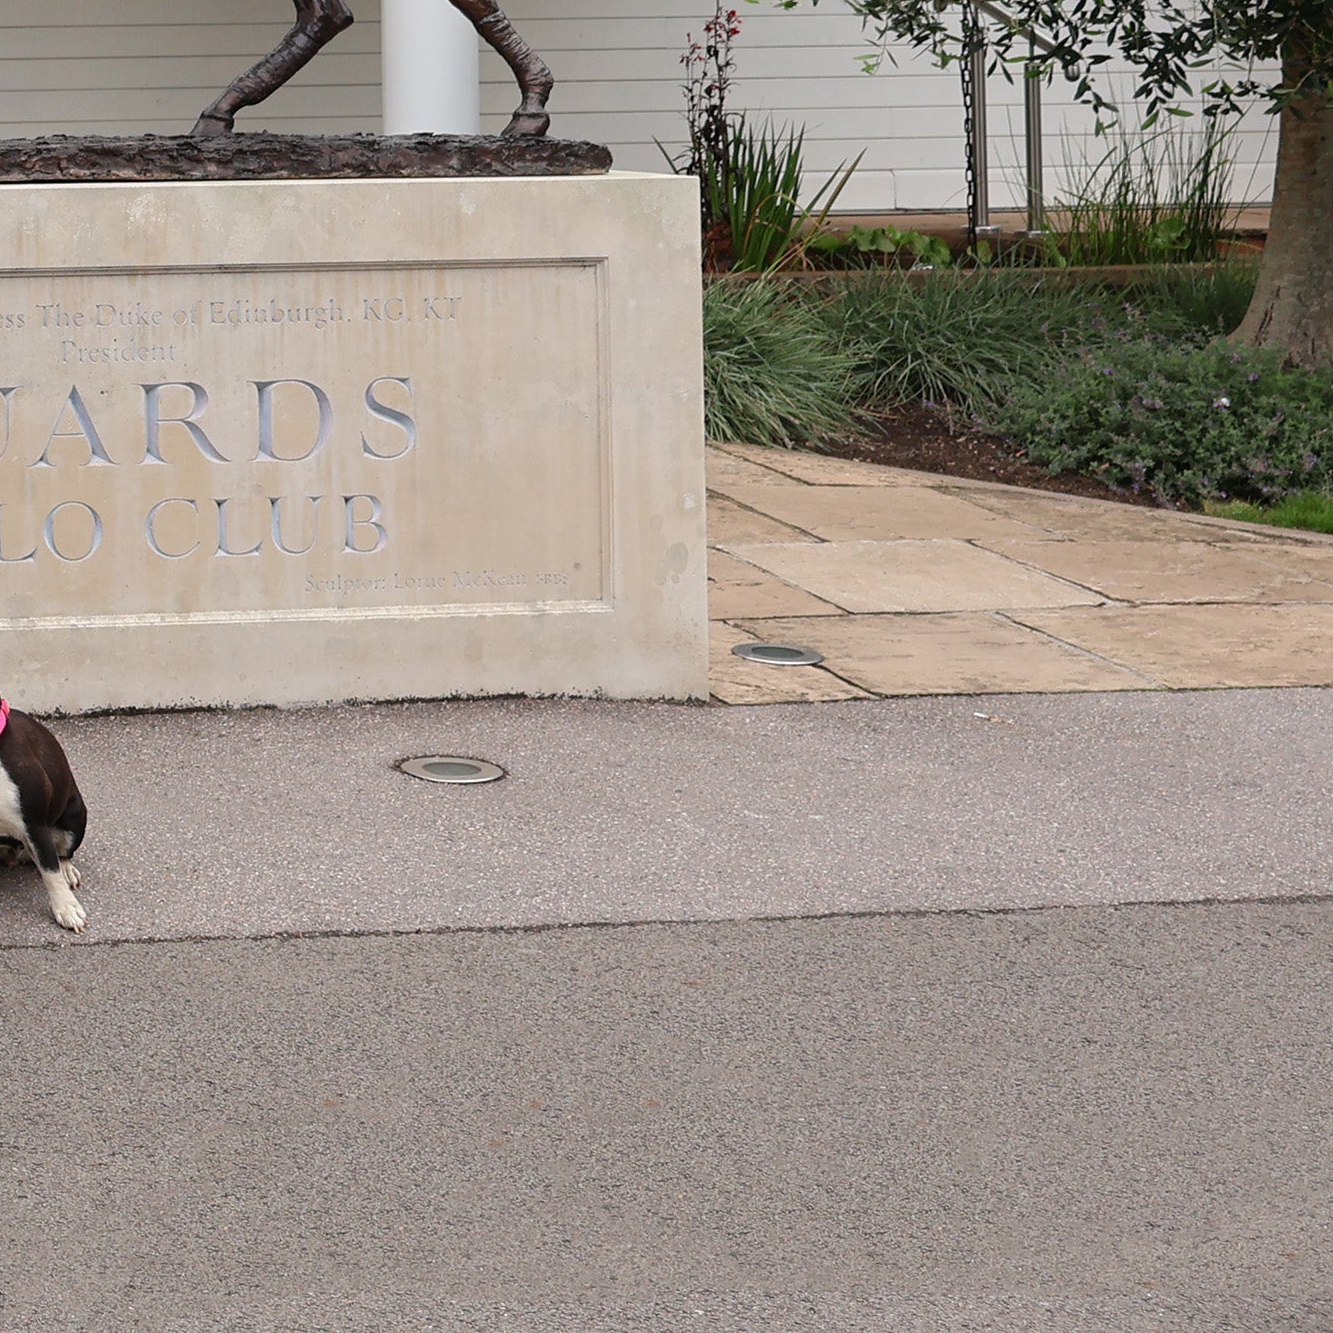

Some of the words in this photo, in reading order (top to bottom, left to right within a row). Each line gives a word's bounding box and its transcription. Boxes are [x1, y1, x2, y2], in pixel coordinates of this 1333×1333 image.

[35, 303, 85, 329] The
[94, 302, 163, 328] Duke
[173, 300, 202, 326] of
[423, 296, 462, 321] KT
[60, 339, 177, 365] President
[145, 493, 391, 559] CLUB
